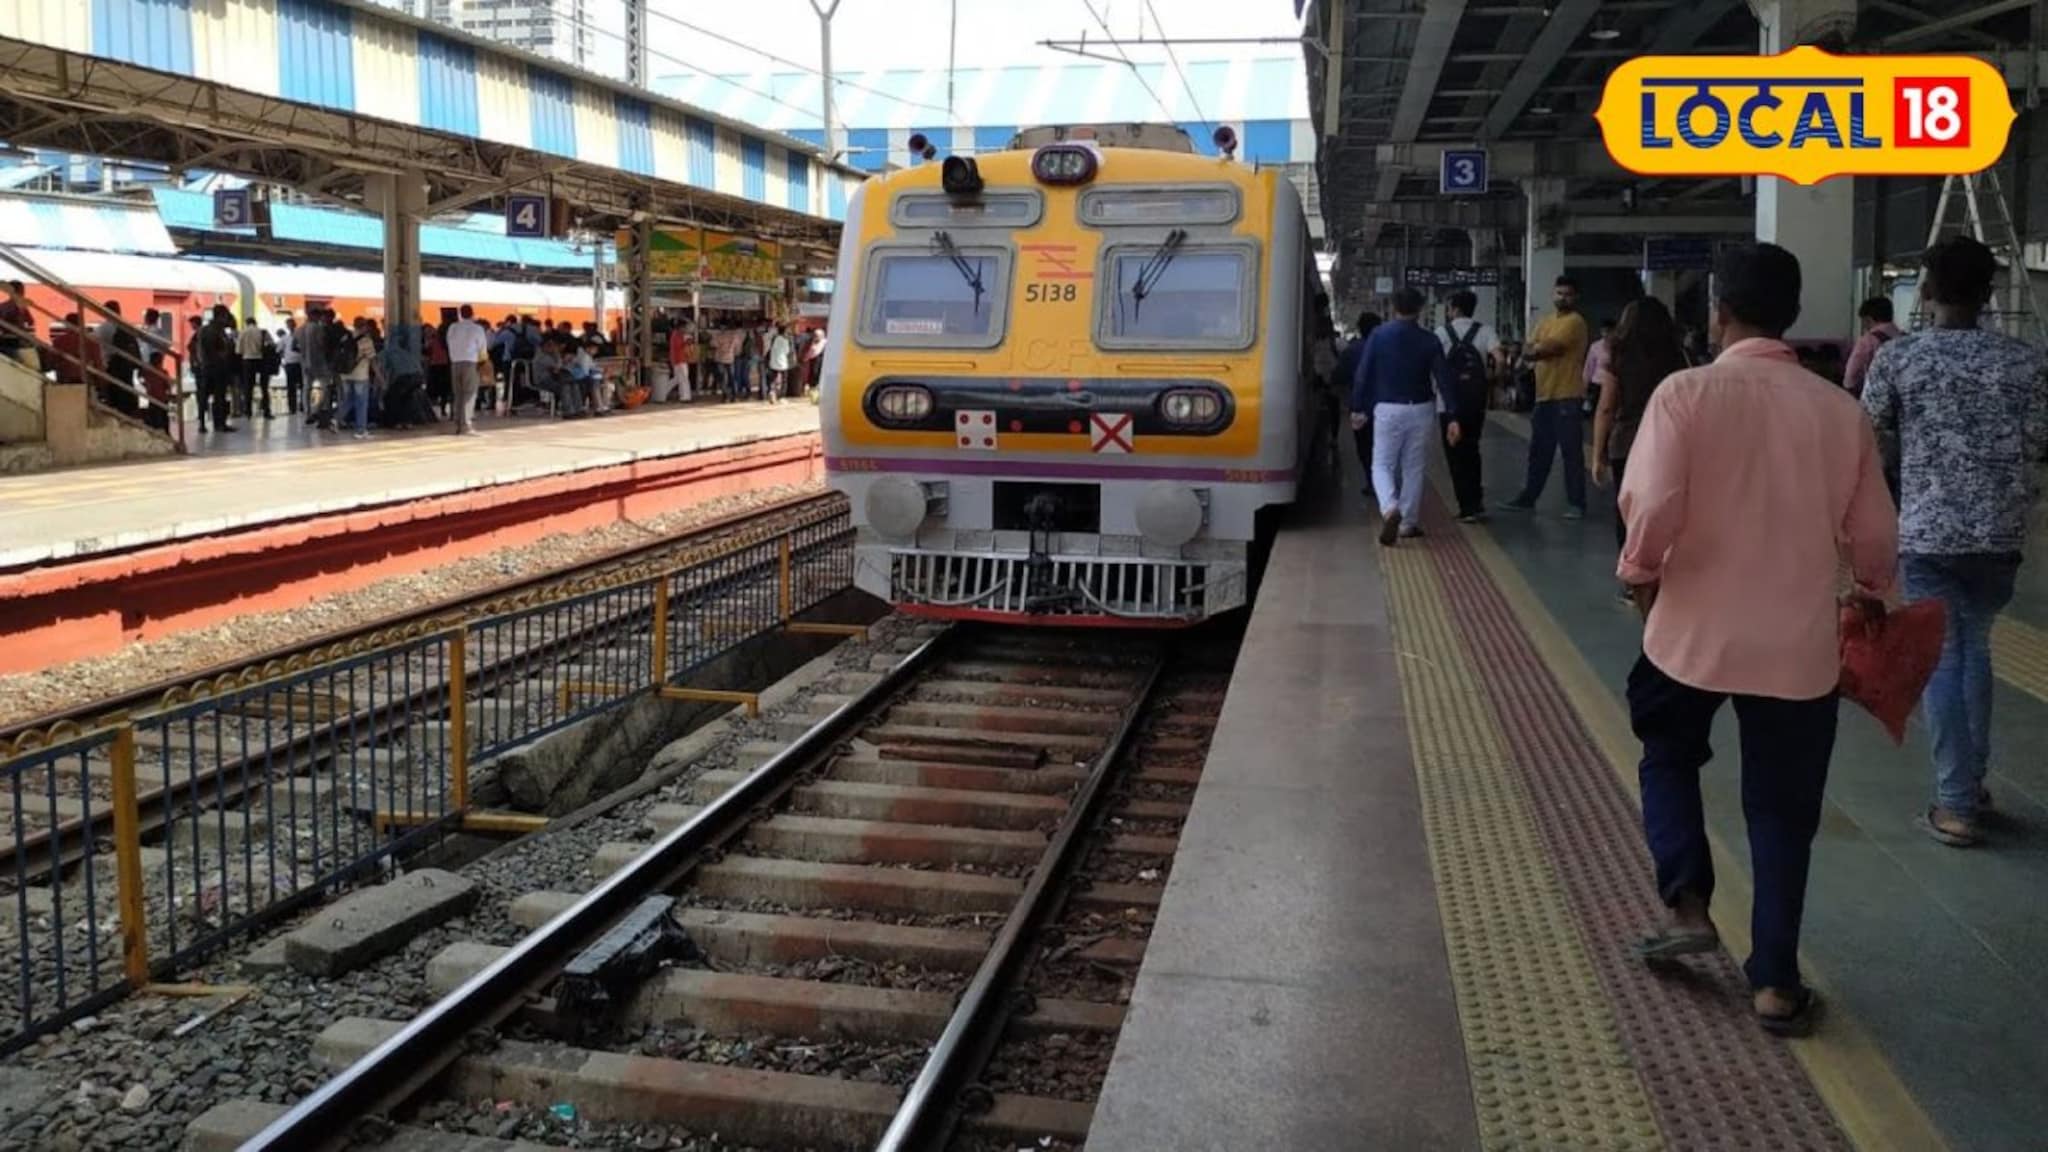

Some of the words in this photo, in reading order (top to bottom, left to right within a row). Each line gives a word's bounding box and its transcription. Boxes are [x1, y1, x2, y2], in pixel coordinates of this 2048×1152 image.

[1454, 159, 1475, 185] 3
[223, 197, 240, 222] 5
[516, 203, 537, 229] 4
[1025, 283, 1077, 303] 5138
